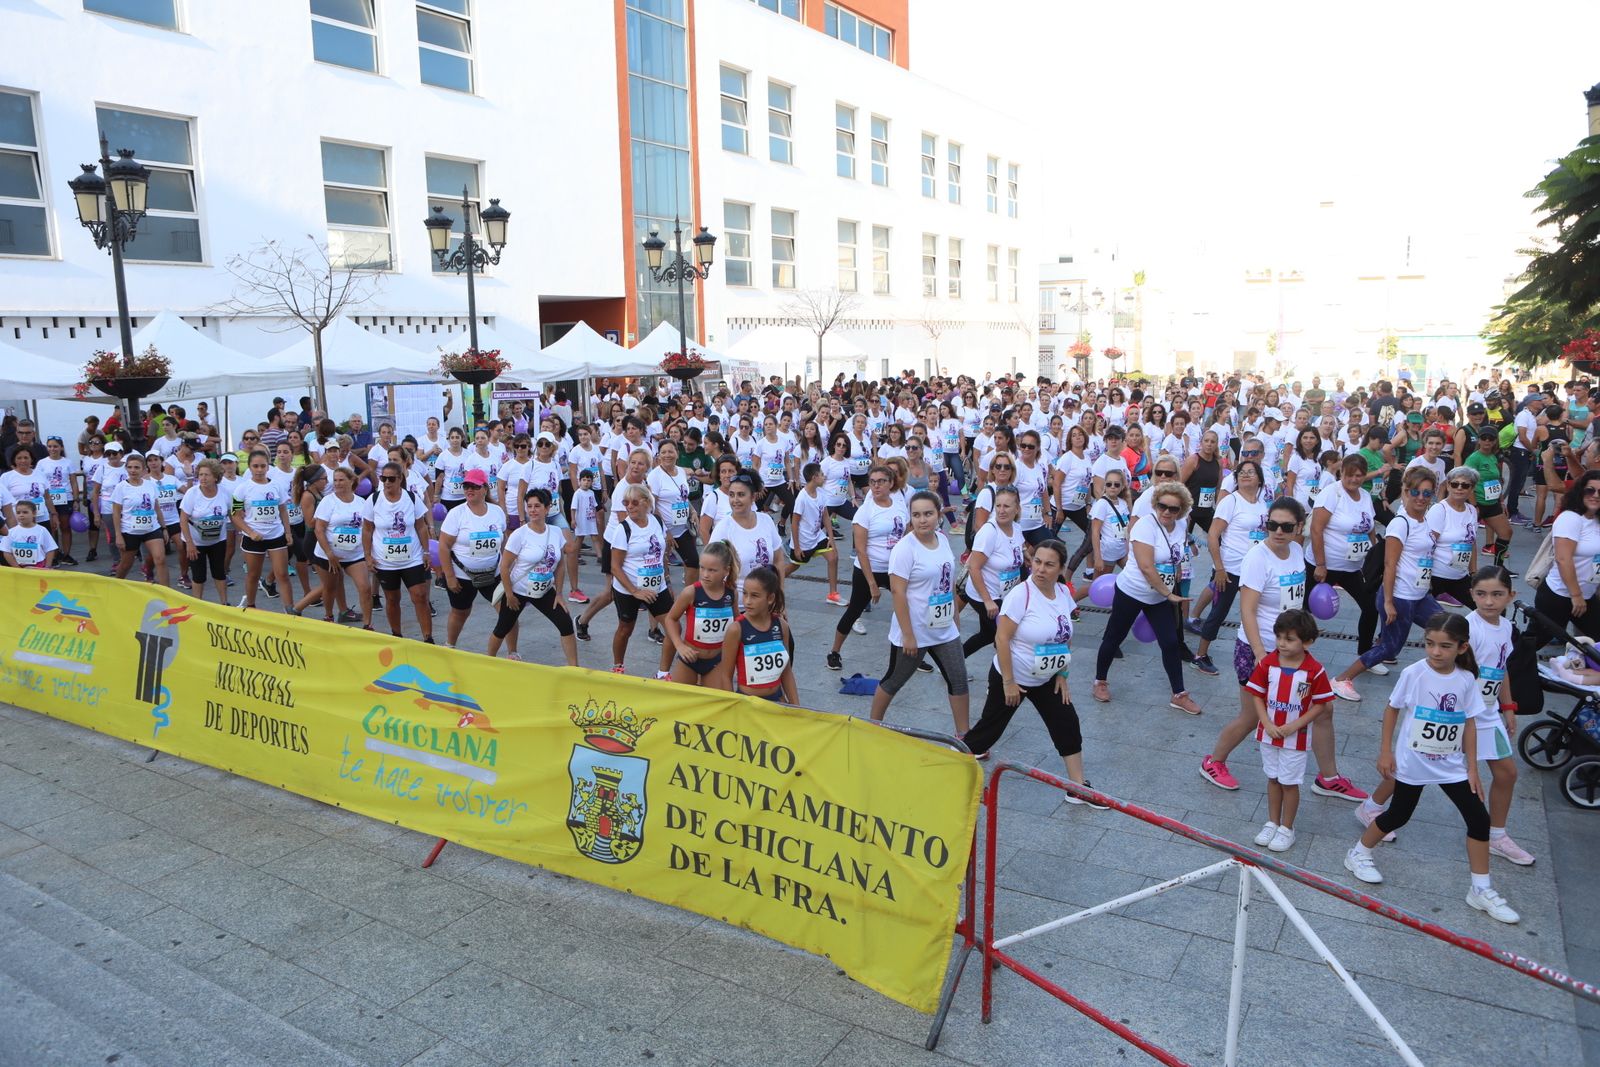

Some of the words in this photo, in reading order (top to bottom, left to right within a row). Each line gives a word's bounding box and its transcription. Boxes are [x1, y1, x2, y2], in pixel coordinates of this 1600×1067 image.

[135, 516, 152, 525] 593
[257, 506, 276, 516] 353
[338, 534, 357, 544] 548
[475, 539, 497, 550] 546
[1352, 542, 1370, 554] 312
[388, 544, 408, 555] 544
[642, 575, 662, 588] 369
[934, 603, 952, 619] 317
[702, 619, 729, 633] 397
[19, 624, 96, 662] CHICLANA
[206, 621, 307, 671] DELEGACIÓN
[753, 653, 784, 672] 396
[1040, 655, 1066, 671] 316
[215, 661, 297, 708] MUNICIPAL
[204, 700, 224, 732] DE
[230, 707, 309, 755] DEPORTES
[362, 704, 498, 767] CHICLANA
[1422, 722, 1458, 742] 508
[673, 720, 803, 777] EXCMO.
[339, 734, 365, 782] te
[373, 752, 424, 801] hace
[436, 778, 528, 826] volver
[668, 761, 949, 869] AYUNTAMIENTO
[664, 802, 708, 839] DE
[714, 819, 897, 903] CHICLANA
[668, 843, 712, 878] DE
[722, 857, 764, 897] LA
[771, 873, 847, 925] FRA.
